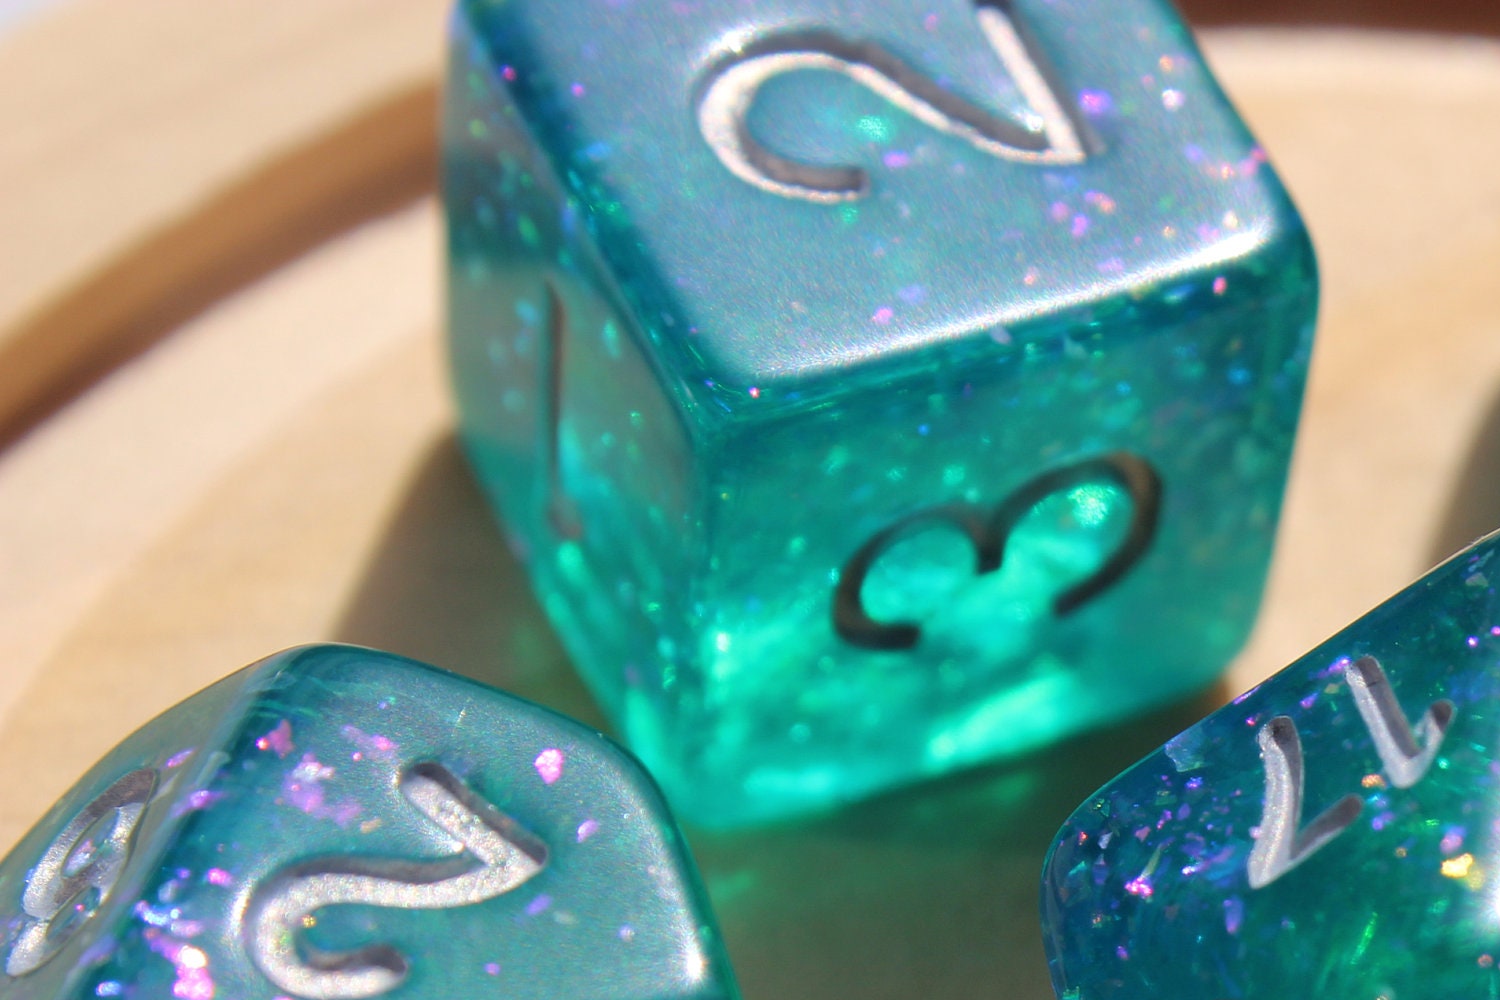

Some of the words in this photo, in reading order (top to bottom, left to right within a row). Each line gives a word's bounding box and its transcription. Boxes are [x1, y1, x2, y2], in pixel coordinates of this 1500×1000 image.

[691, 0, 1098, 205] 2
[831, 452, 1163, 653] 3
[243, 761, 549, 1000] 2
[1247, 654, 1456, 889] 17
